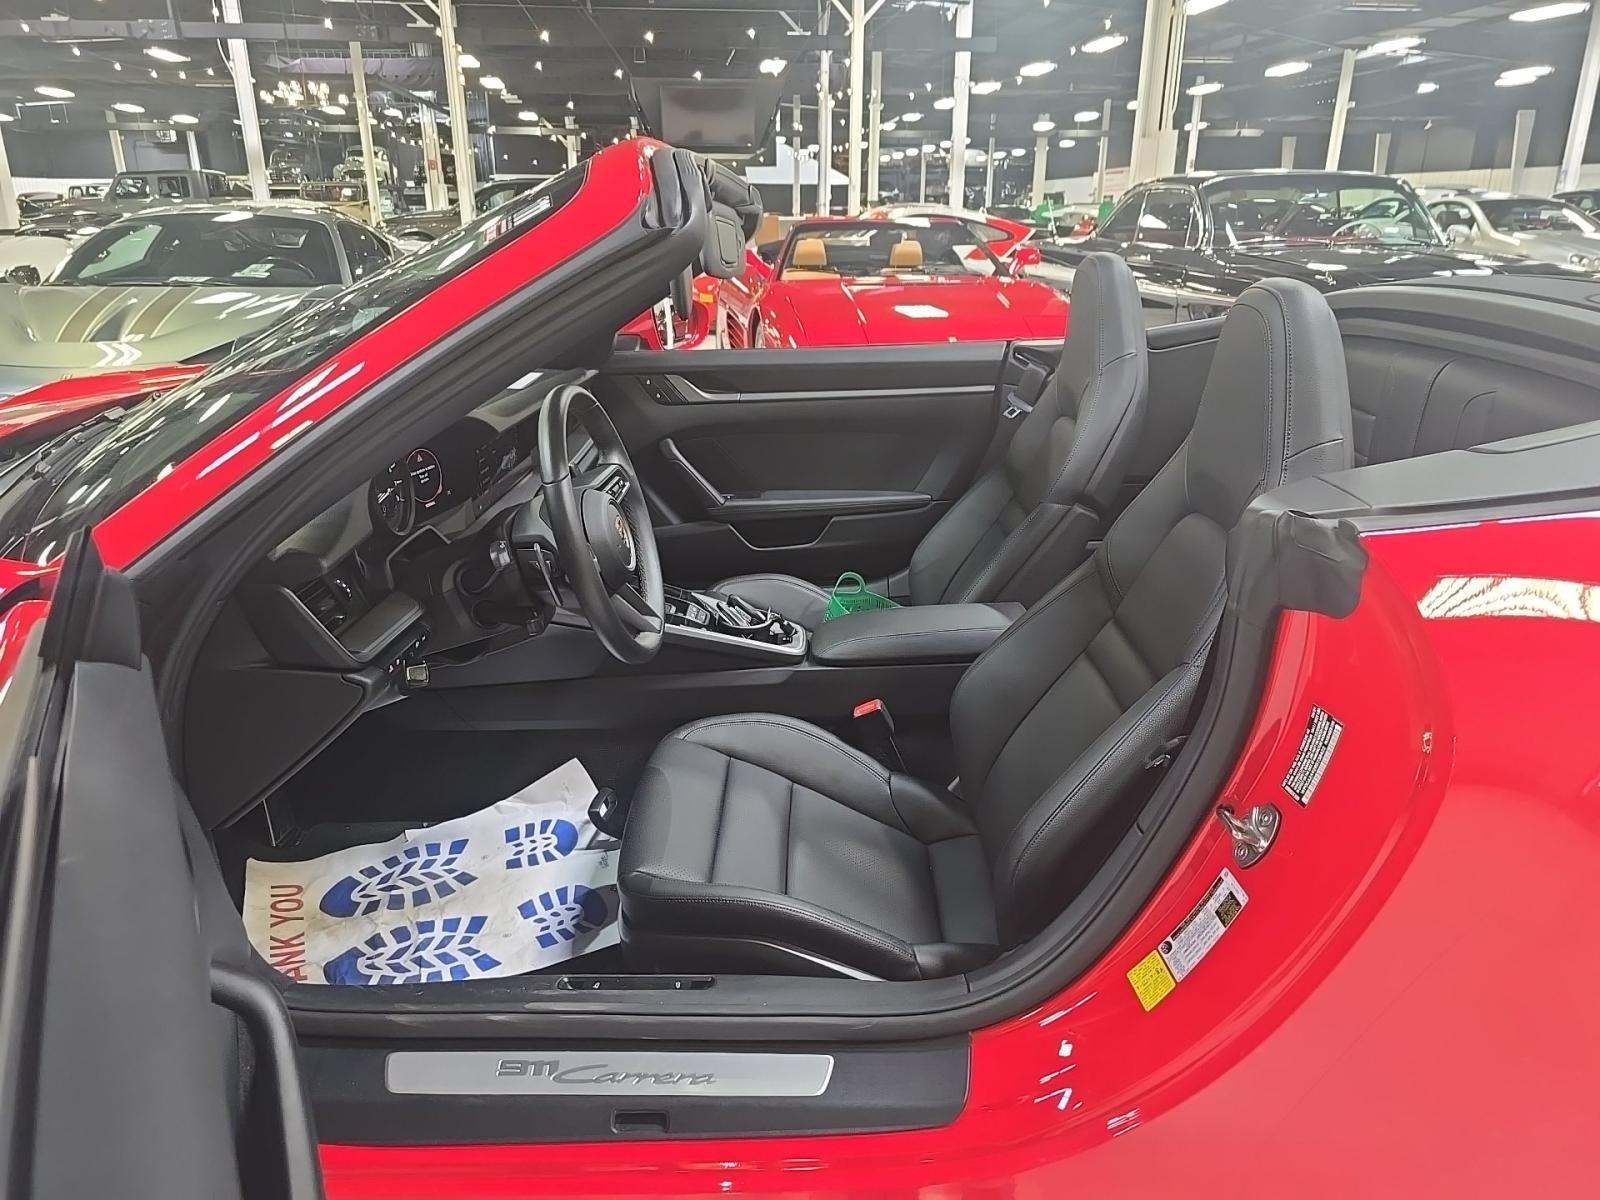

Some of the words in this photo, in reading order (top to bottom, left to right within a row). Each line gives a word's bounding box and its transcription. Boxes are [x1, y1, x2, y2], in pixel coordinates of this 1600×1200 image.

[269, 884, 305, 929] YOU
[496, 1059, 560, 1077] 911
[550, 1063, 717, 1085] Carrera
